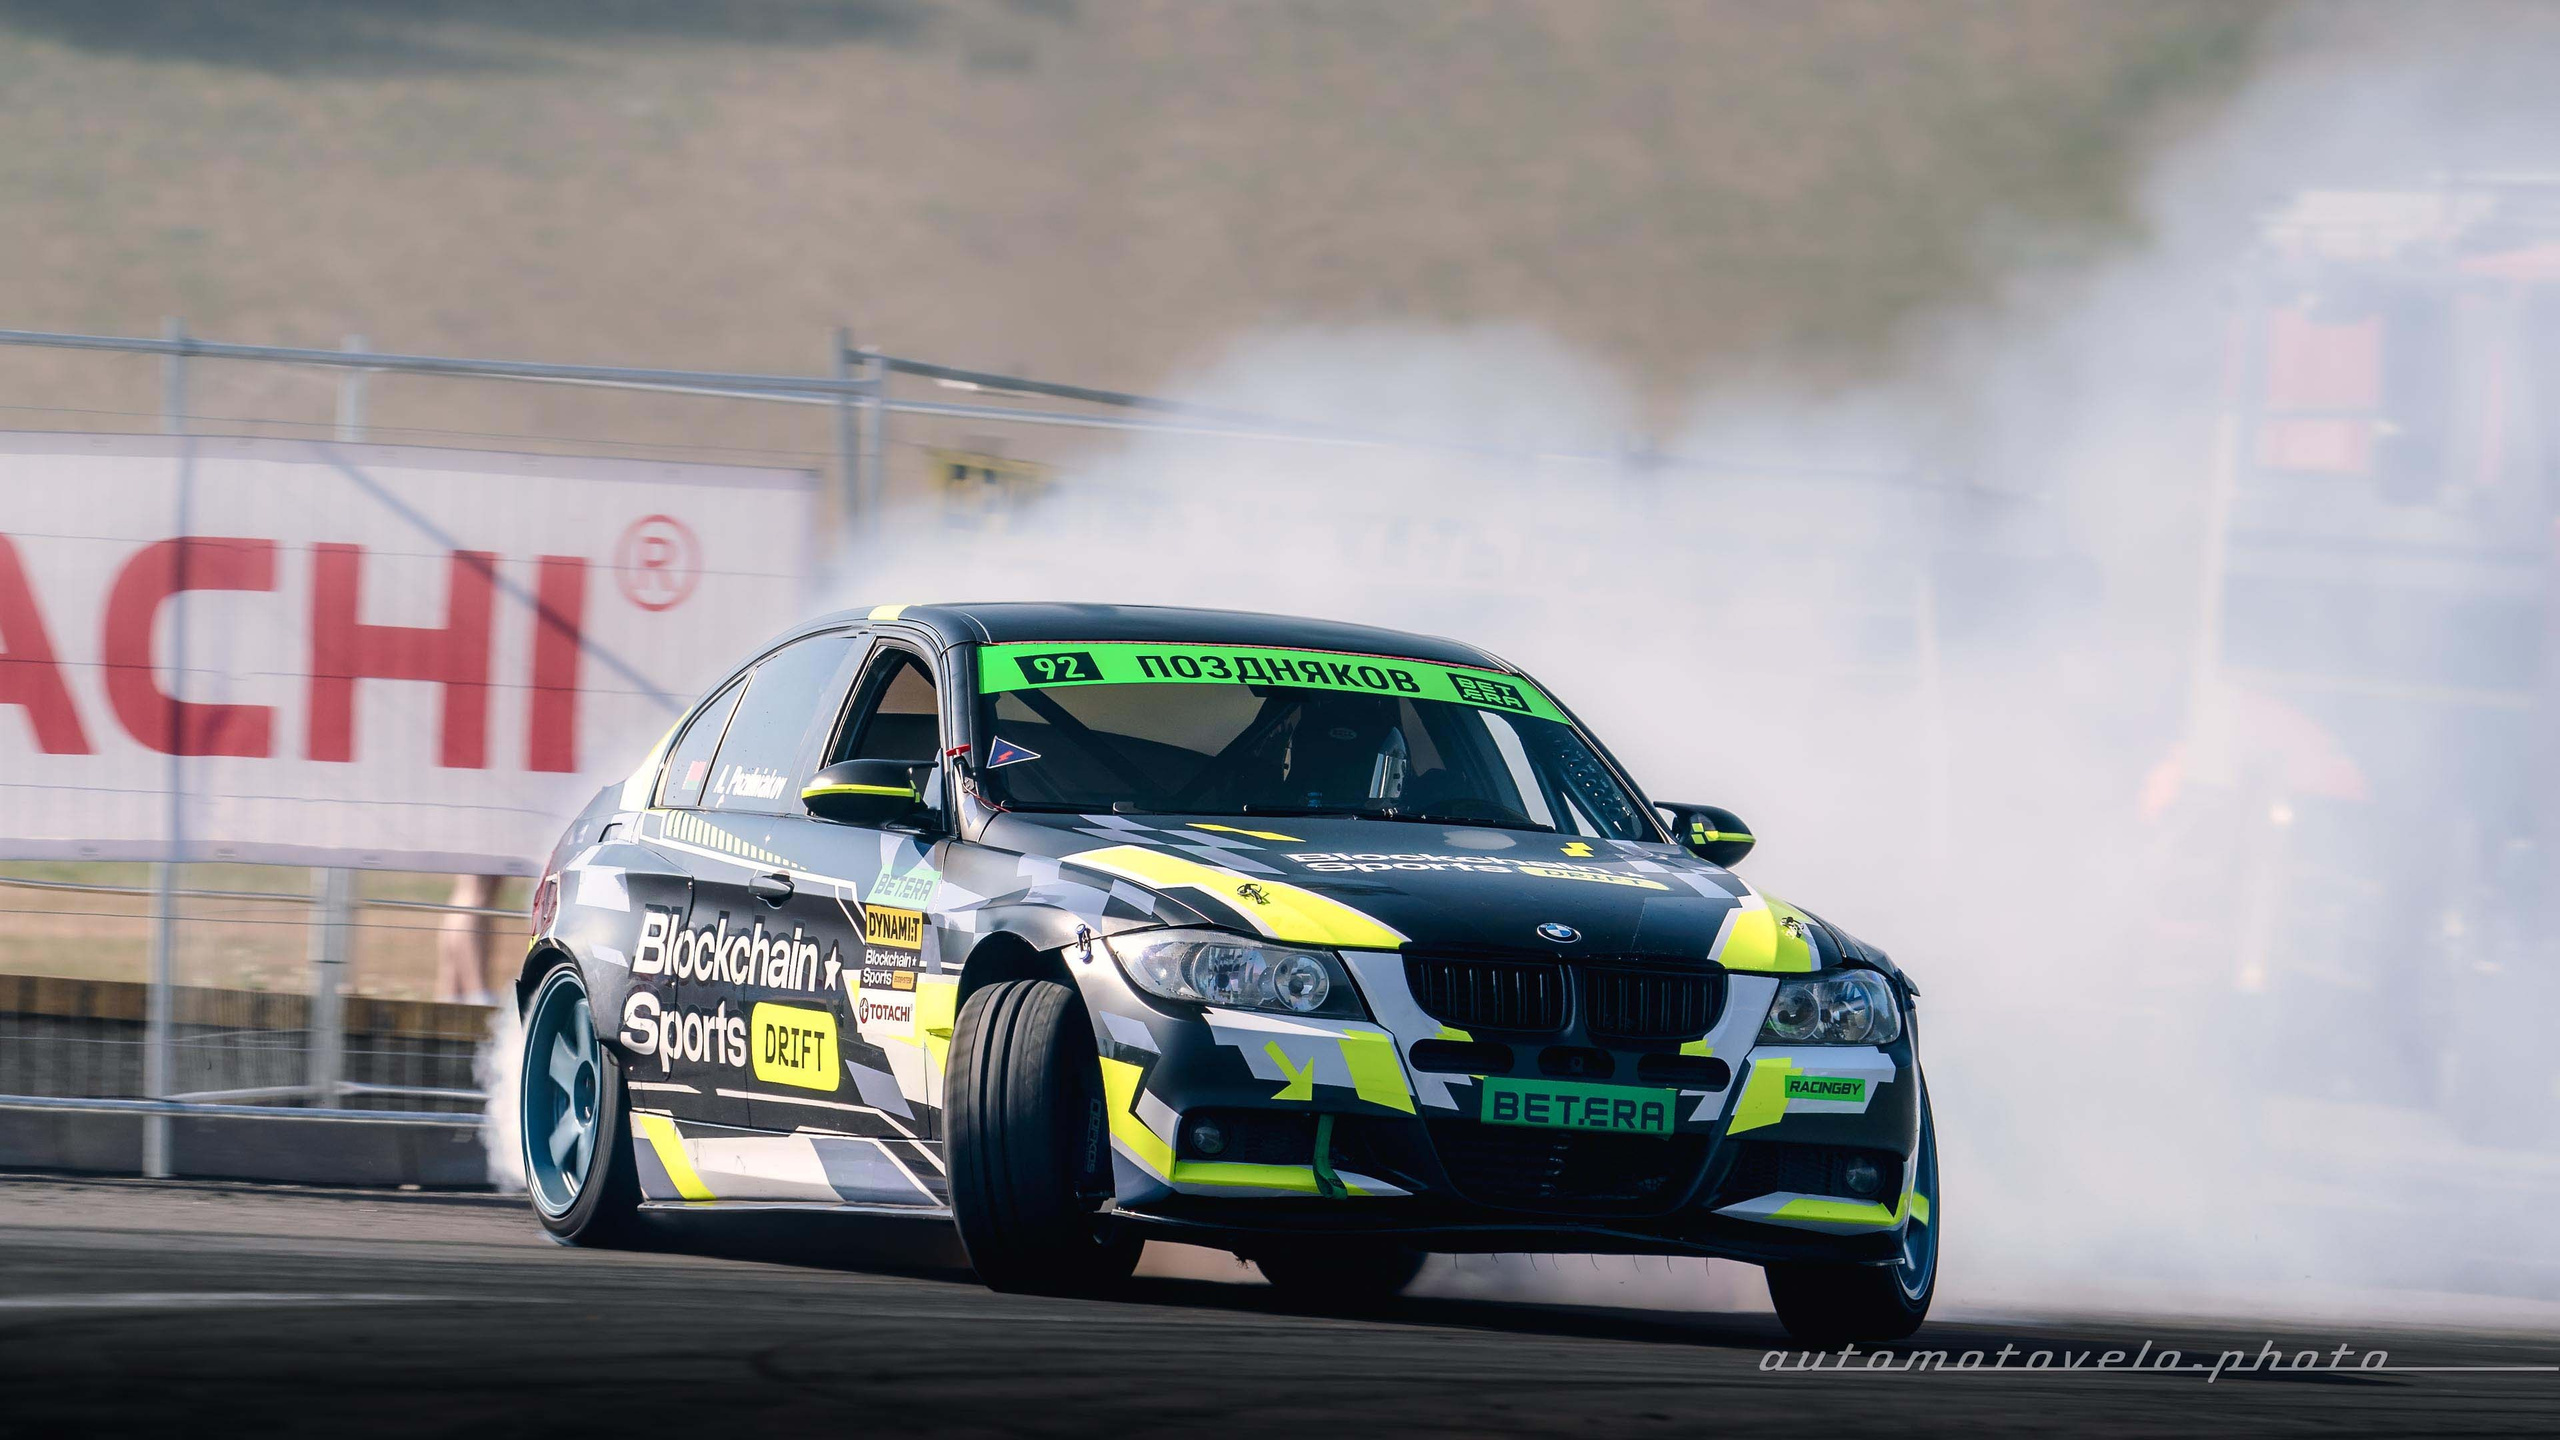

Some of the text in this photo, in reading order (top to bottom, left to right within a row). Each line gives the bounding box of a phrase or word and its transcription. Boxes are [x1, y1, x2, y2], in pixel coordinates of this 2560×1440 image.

[1034, 655, 1421, 693] 92 ПОЗДНЯКОВ
[1455, 676, 1511, 695] BET
[1281, 853, 1614, 875] Blockchain
[1306, 862, 1643, 886] Sports DRIFT
[632, 911, 819, 993] Blockchain
[865, 949, 912, 968] Blockchain
[862, 967, 892, 987] Sports
[619, 991, 826, 1074] Sports DRIFT
[1789, 1080, 1863, 1096] RACINGBY
[1493, 1090, 1665, 1131] BET.ERA
